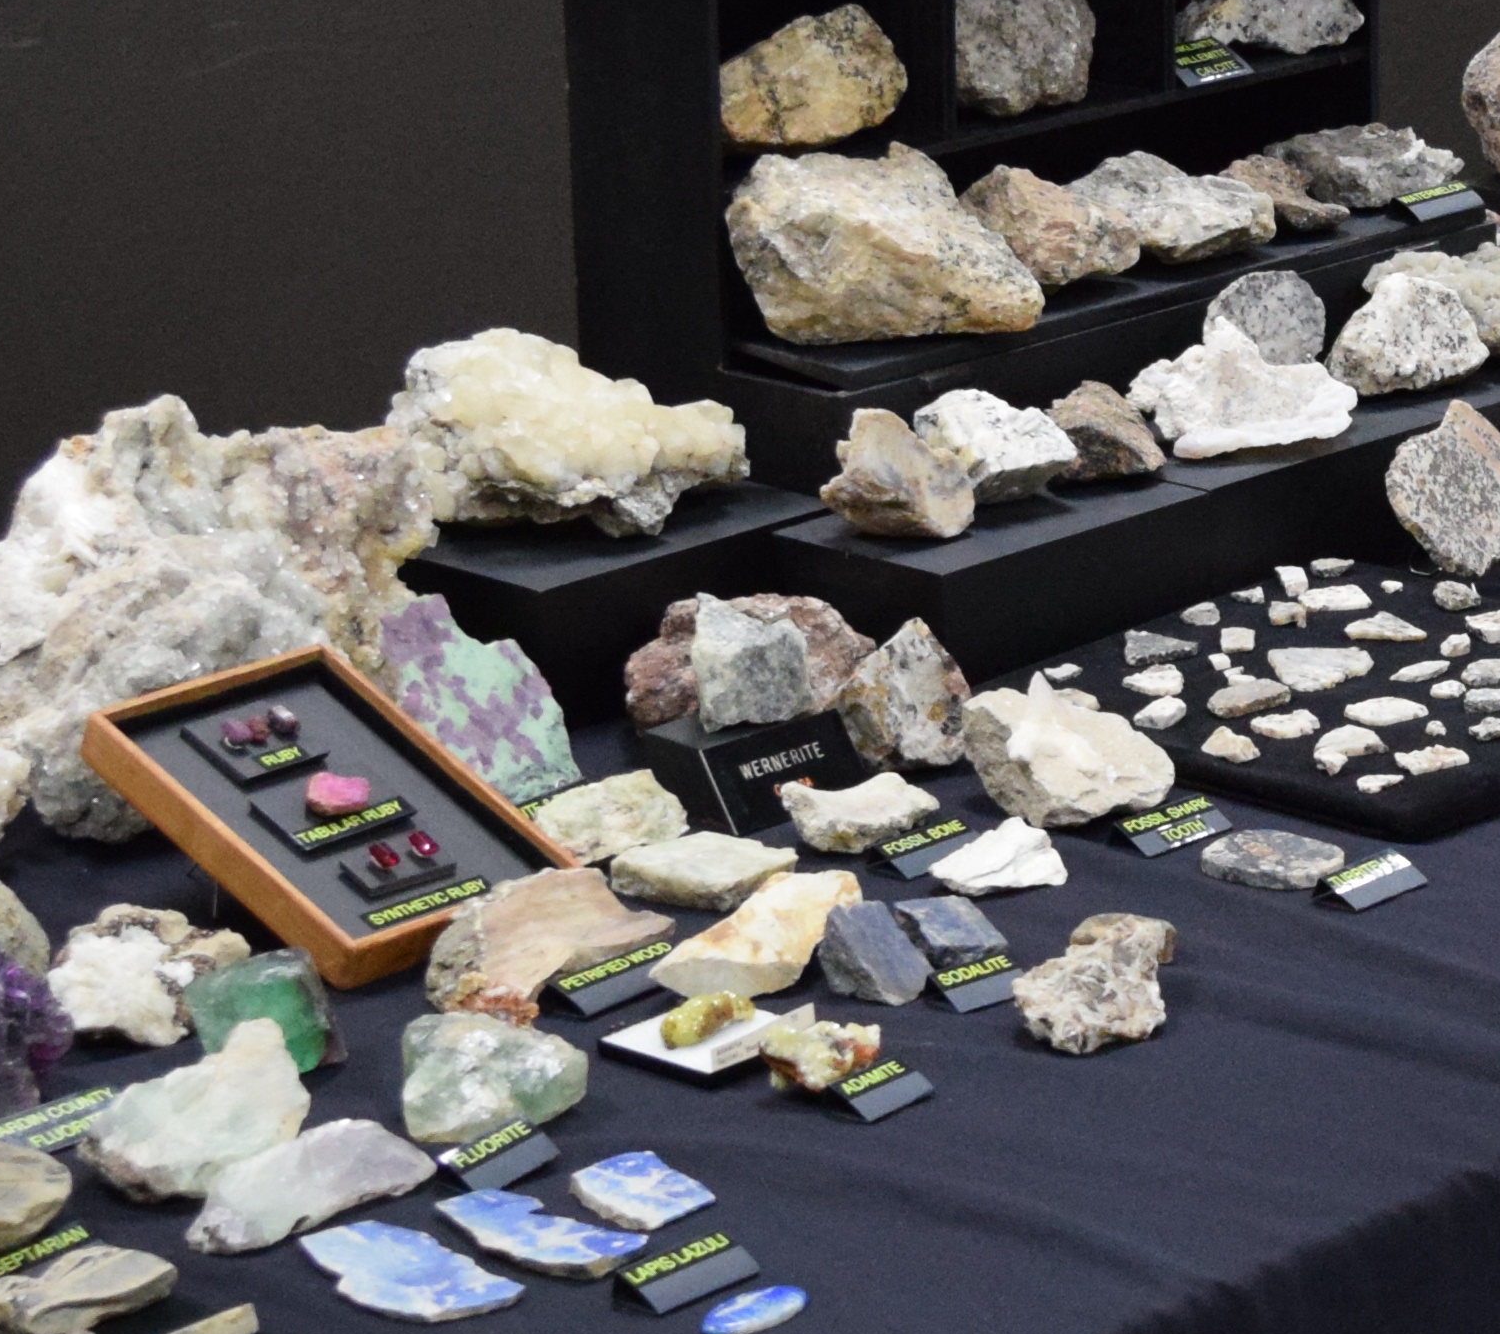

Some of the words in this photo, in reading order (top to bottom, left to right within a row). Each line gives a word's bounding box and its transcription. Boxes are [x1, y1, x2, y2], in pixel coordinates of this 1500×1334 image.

[1196, 59, 1240, 77] CALCITE
[1397, 182, 1467, 204] WATERMELON
[260, 745, 302, 766] RUBY
[738, 741, 825, 780] WERNERITE
[296, 815, 365, 845] TABULAR
[361, 800, 403, 822] RUBY
[1122, 811, 1171, 833] FOSSIL
[1166, 796, 1213, 819] SHARK
[1161, 819, 1207, 842] TOOTH
[882, 833, 932, 856] FOSSIL
[927, 819, 966, 839] BONE
[369, 891, 450, 927] SYNTHETIC
[449, 878, 487, 899] RUBY
[559, 958, 631, 990] PETRIFIED
[625, 942, 672, 964] WOOD
[937, 955, 1012, 986] SODALITE
[840, 1060, 905, 1096] ADAMITE
[46, 1087, 113, 1118] COUNTY
[455, 1120, 532, 1168] FLUORITE
[624, 1256, 677, 1284] LAPIS
[669, 1232, 730, 1264] LAZULI
